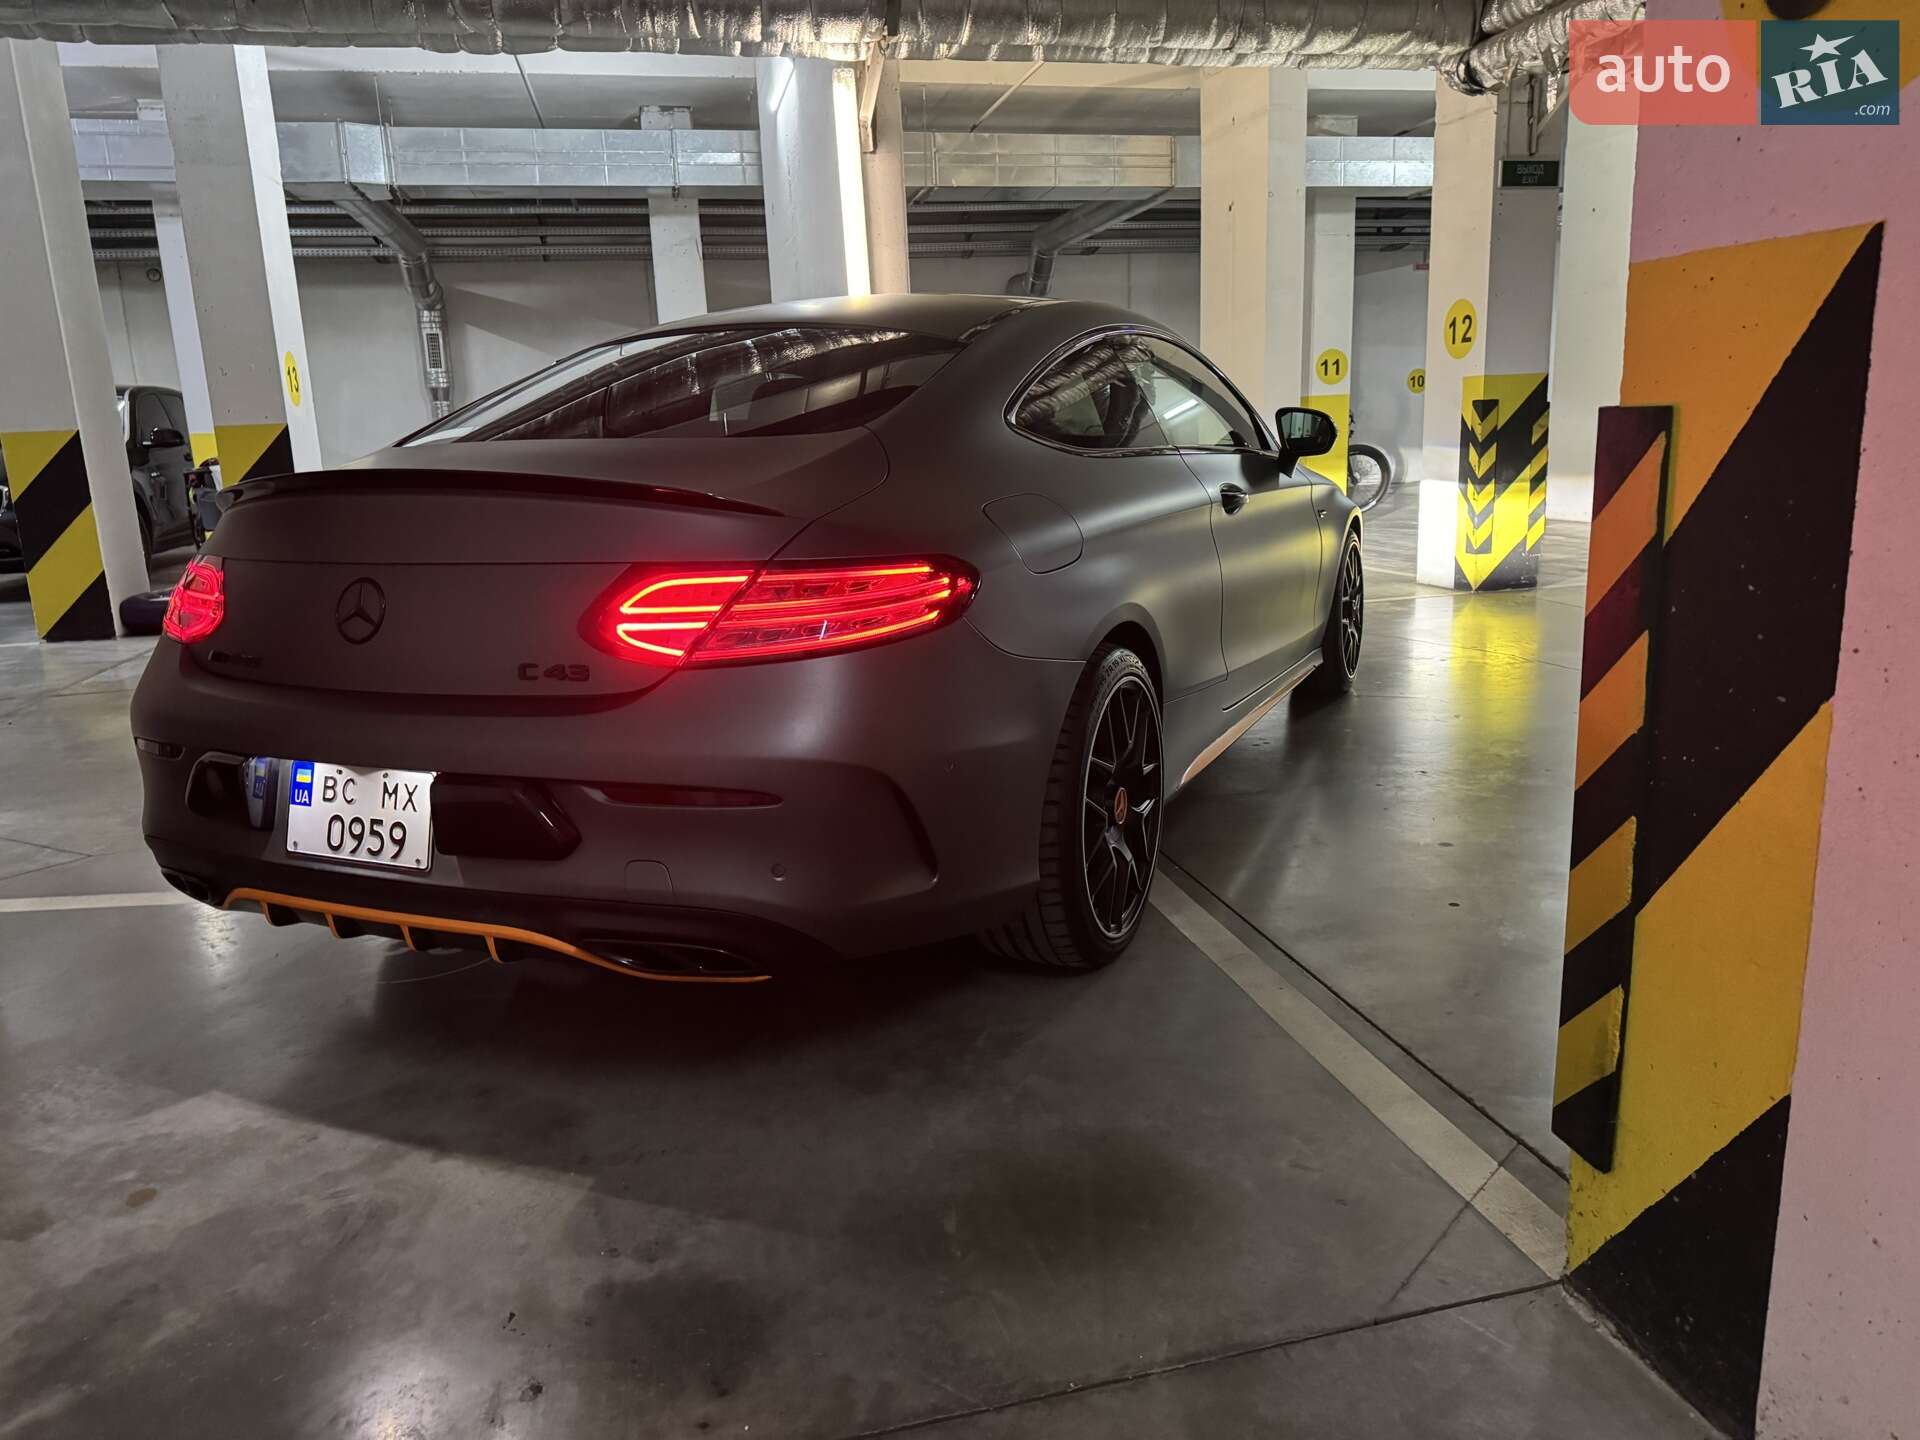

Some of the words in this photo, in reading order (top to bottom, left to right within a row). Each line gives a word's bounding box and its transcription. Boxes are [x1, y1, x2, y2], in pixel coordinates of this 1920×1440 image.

[1449, 314, 1473, 345] 12
[1320, 358, 1341, 376] 11
[287, 366, 299, 393] 13
[1410, 375, 1425, 388] 10
[518, 662, 539, 681] C
[543, 663, 591, 682] 43
[294, 788, 310, 805] UA
[322, 775, 357, 806] BC
[381, 781, 418, 813] MX
[326, 814, 408, 860] 0959
